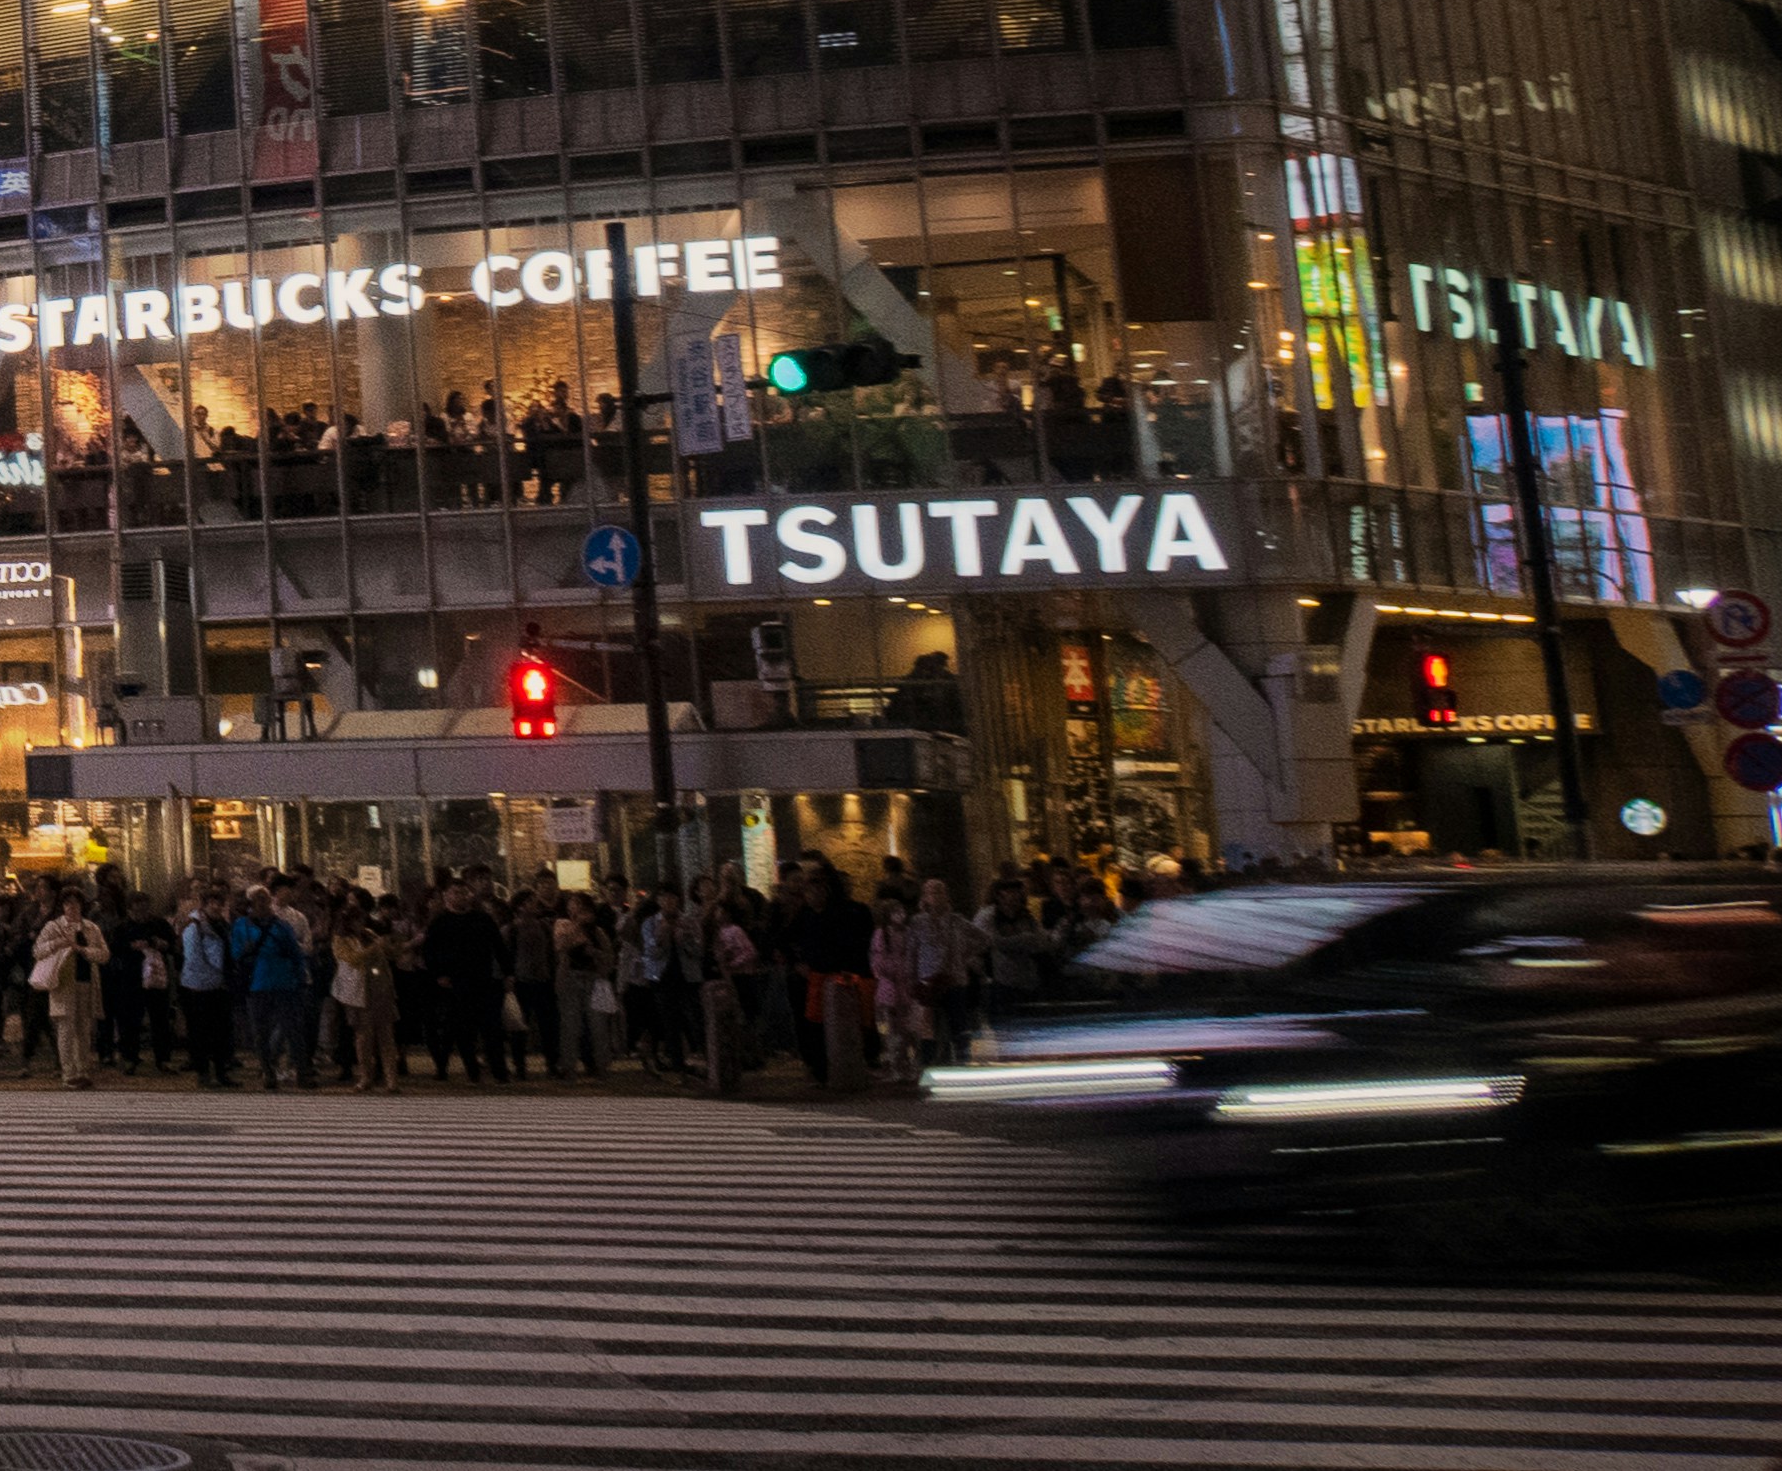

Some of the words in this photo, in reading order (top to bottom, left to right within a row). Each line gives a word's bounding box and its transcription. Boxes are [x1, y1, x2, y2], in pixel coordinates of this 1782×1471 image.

[471, 235, 784, 309] COFFEE
[1407, 261, 1655, 369] TSTAYA
[700, 492, 1230, 586] TSUTAYA
[1351, 714, 1494, 735] STARKS
